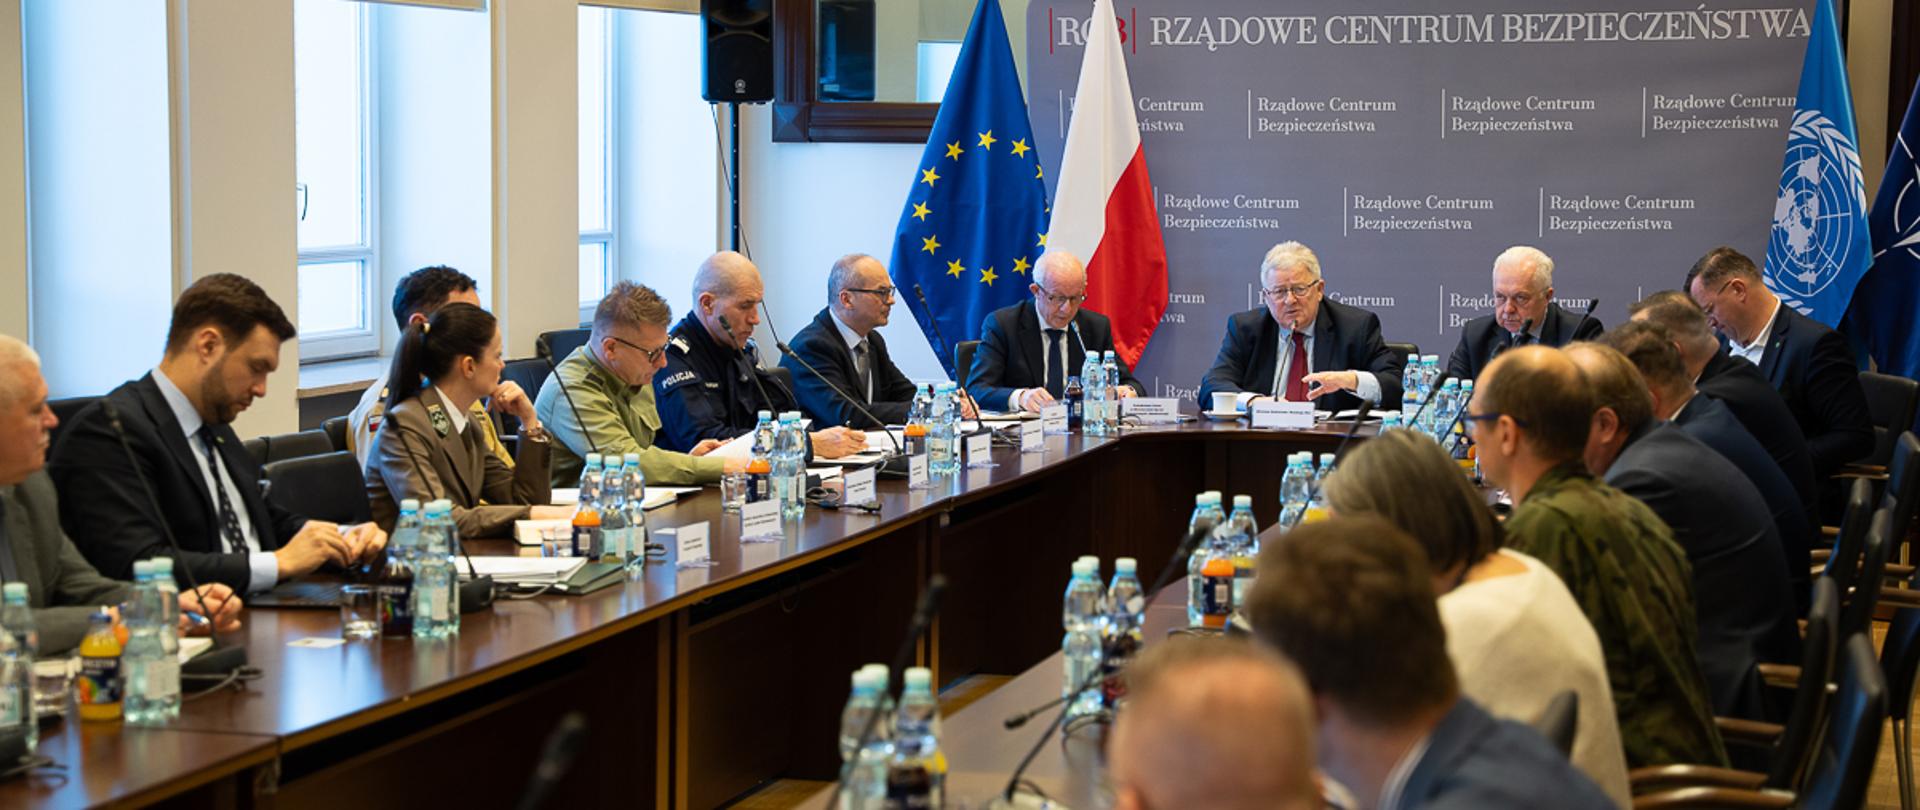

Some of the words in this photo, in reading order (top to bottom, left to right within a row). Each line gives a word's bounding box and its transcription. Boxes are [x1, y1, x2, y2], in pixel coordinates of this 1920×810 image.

[1149, 16, 1317, 51] RZĄDOWE
[1324, 14, 1495, 44] CENTRUM
[1501, 4, 1811, 42] BEZPIECZEŃSTWA
[1138, 97, 1204, 111] Centrum
[1257, 97, 1325, 115] Rządowe
[1329, 97, 1397, 112] Centrum
[1452, 96, 1522, 114] Rządowe
[1525, 96, 1595, 111] Centrum
[1653, 94, 1726, 112] Rządowe
[1257, 117, 1376, 135] Bezpieczeństwa
[1452, 117, 1574, 135] Bezpieczeństwa
[1652, 115, 1779, 134] Bezpieczeństwa
[1164, 194, 1230, 212] Rządowe
[1233, 194, 1300, 209] Centrum
[1353, 195, 1421, 213] Rządowe
[1425, 195, 1494, 210] Centrum
[1550, 195, 1620, 213] Rządowe
[1625, 195, 1695, 210] Centrum
[1164, 214, 1279, 231] Bezpieczeństwa
[1353, 215, 1473, 233] Bezpieczeństwa
[1549, 215, 1673, 234] Bezpieczeństwa
[1169, 292, 1205, 304] trum
[1450, 293, 1496, 311] Rządo
[661, 370, 696, 389] POLICJA
